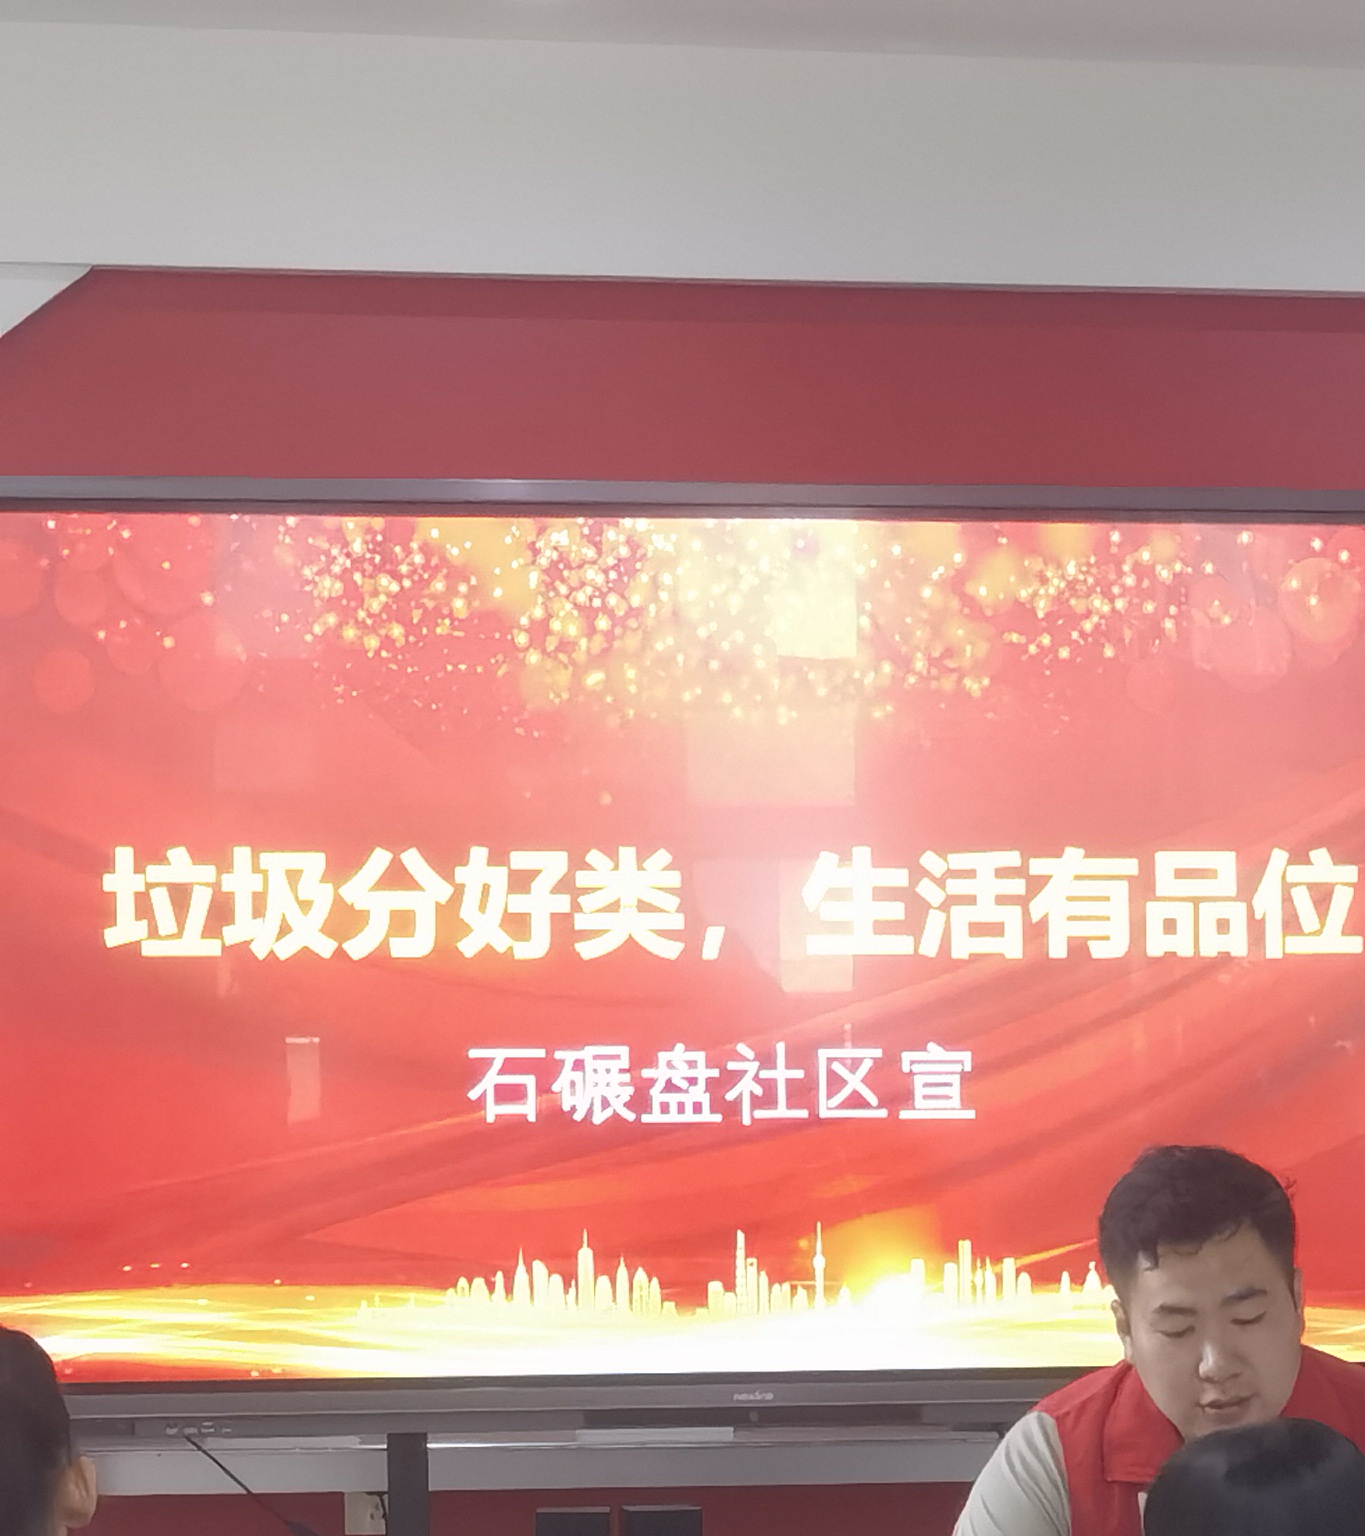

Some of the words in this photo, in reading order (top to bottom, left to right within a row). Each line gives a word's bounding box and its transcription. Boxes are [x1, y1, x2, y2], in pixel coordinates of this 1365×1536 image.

[102, 844, 1364, 963] 垃圾分好类，生活有品位
[466, 1041, 978, 1125] 石碾盘社区宣
